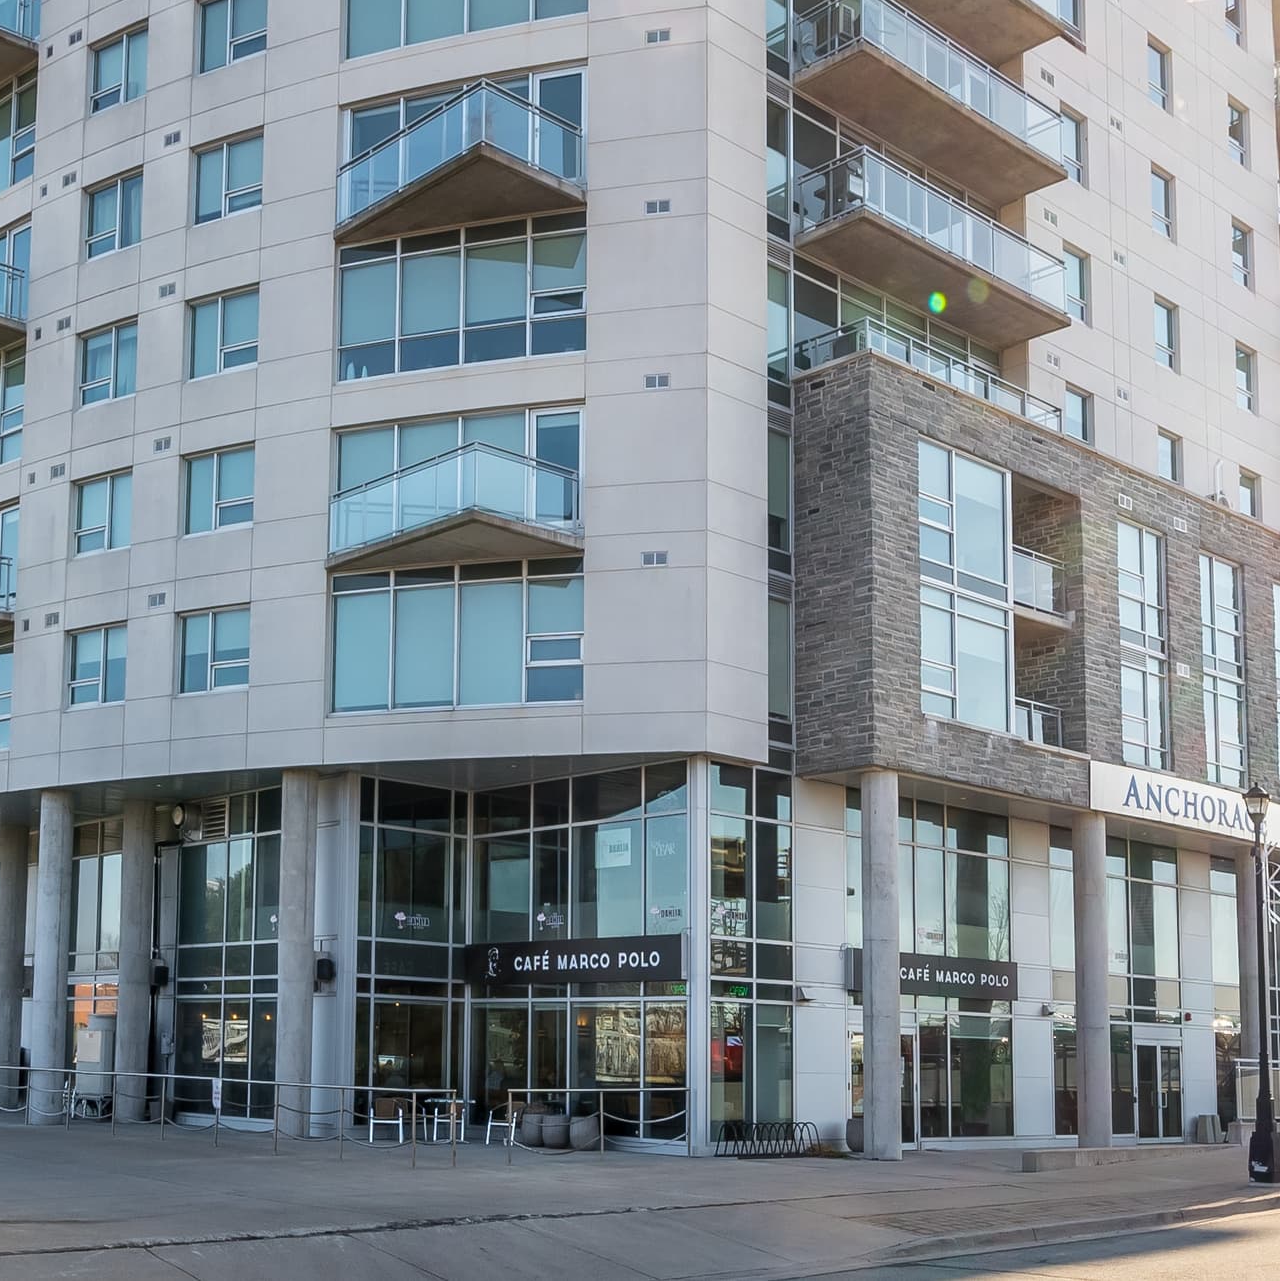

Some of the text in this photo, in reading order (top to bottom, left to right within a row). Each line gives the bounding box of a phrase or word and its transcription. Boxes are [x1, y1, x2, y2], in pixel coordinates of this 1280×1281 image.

[1122, 773, 1266, 835] ANCHORA
[513, 949, 661, 971] CAFÉ MARCO POLO
[899, 963, 1010, 988] CAFÉ MARCO POLO
